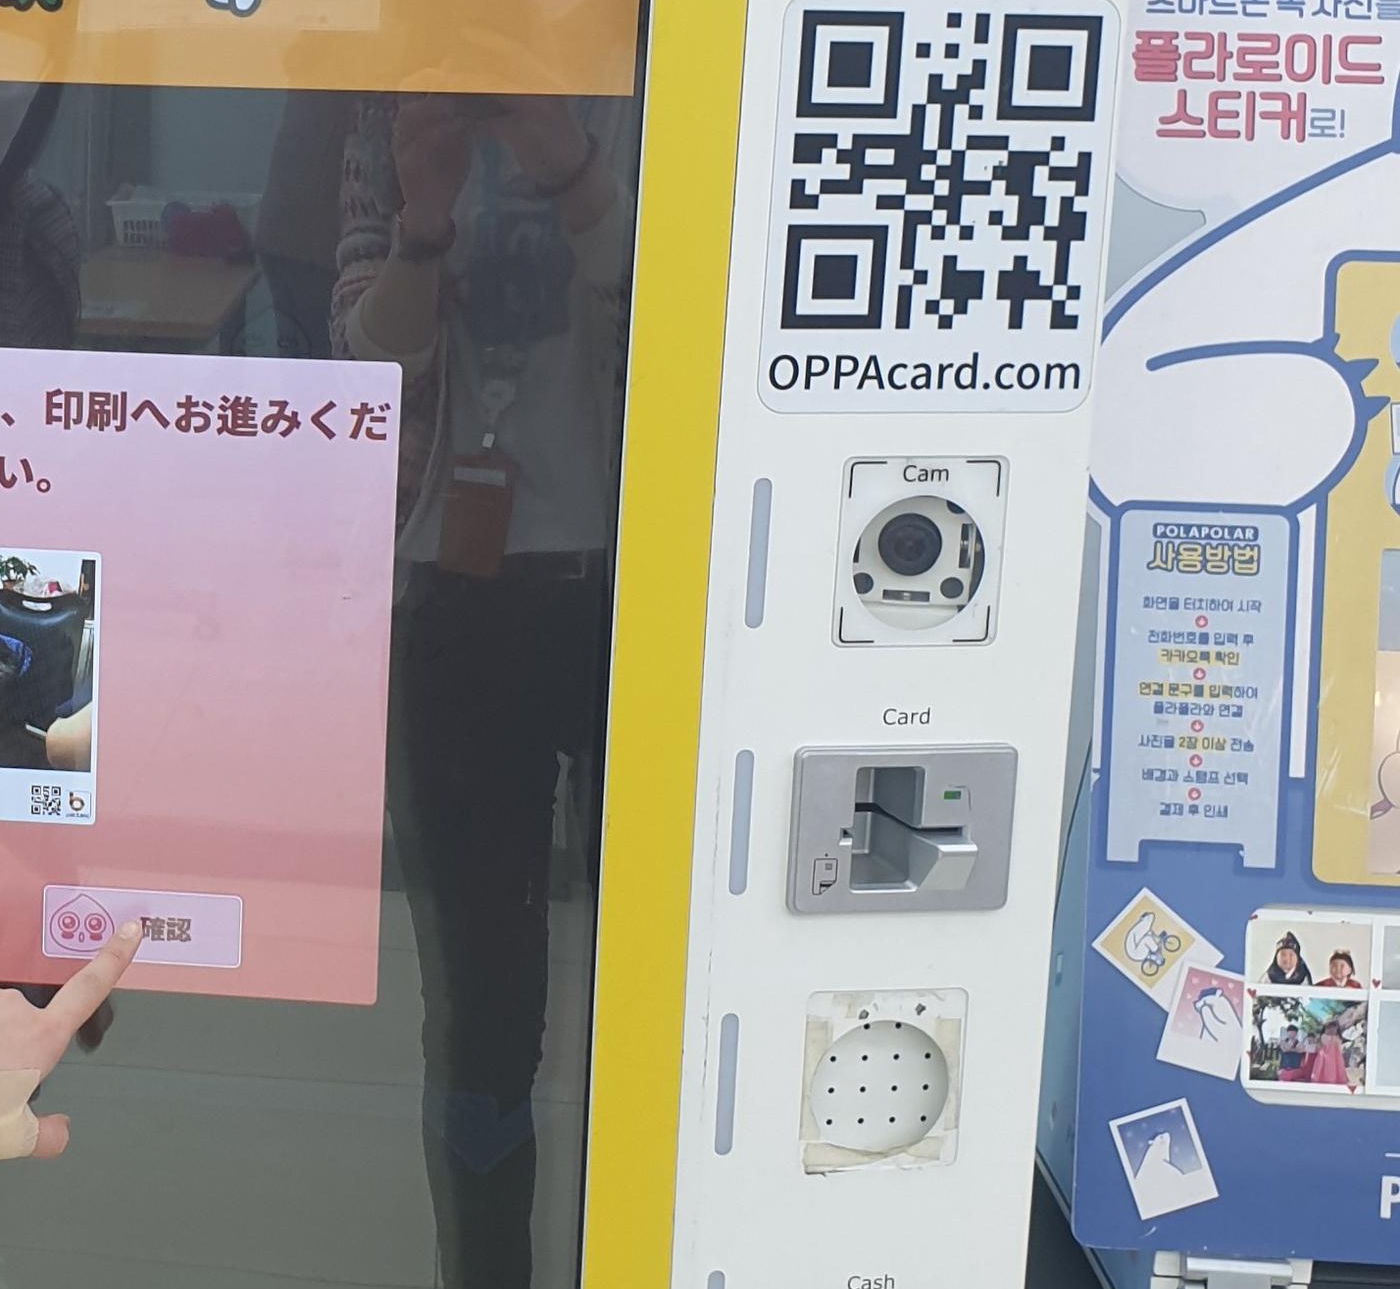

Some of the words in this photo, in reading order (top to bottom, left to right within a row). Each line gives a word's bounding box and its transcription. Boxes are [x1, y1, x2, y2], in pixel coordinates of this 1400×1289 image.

[1132, 30, 1385, 85] 폴라로이드
[768, 351, 1081, 391] OPPAcard.com
[902, 464, 950, 483] Cam
[1156, 524, 1255, 540] POLAPOLAR
[1147, 540, 1261, 576] 사용방법
[1183, 597, 1234, 611] 터치하여
[1237, 598, 1262, 613] 시작
[1214, 632, 1238, 646] 입력
[882, 707, 931, 726] Card
[1138, 734, 1175, 749] 사진을
[1202, 737, 1227, 751] 이상
